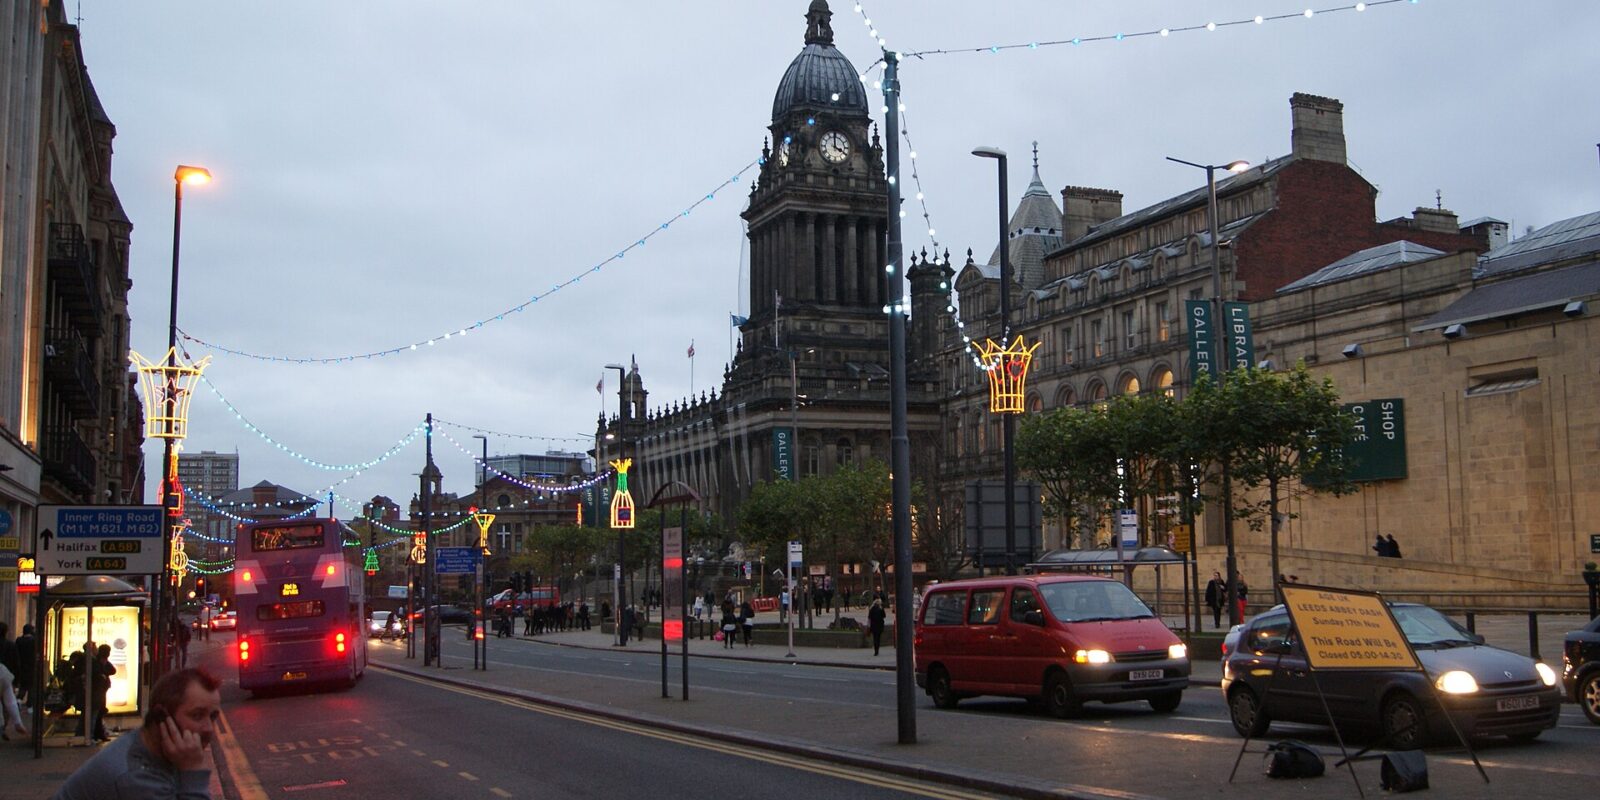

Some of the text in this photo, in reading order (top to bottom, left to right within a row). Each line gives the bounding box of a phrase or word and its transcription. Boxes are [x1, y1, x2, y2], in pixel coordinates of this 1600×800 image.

[1193, 306, 1209, 372] GALLER
[1231, 307, 1248, 368] LIBRAR
[1381, 401, 1395, 440] SHOP
[777, 432, 788, 480] GALLERY
[65, 512, 155, 523] Inner Ring Road
[57, 542, 97, 552] Halifax
[57, 560, 82, 569] York
[1297, 604, 1383, 616] LEEDS ABBEY DASH
[69, 616, 85, 626] big
[1312, 617, 1344, 627] Sunday
[1311, 636, 1397, 648] This Road Will Be
[1318, 650, 1348, 659] Closed
